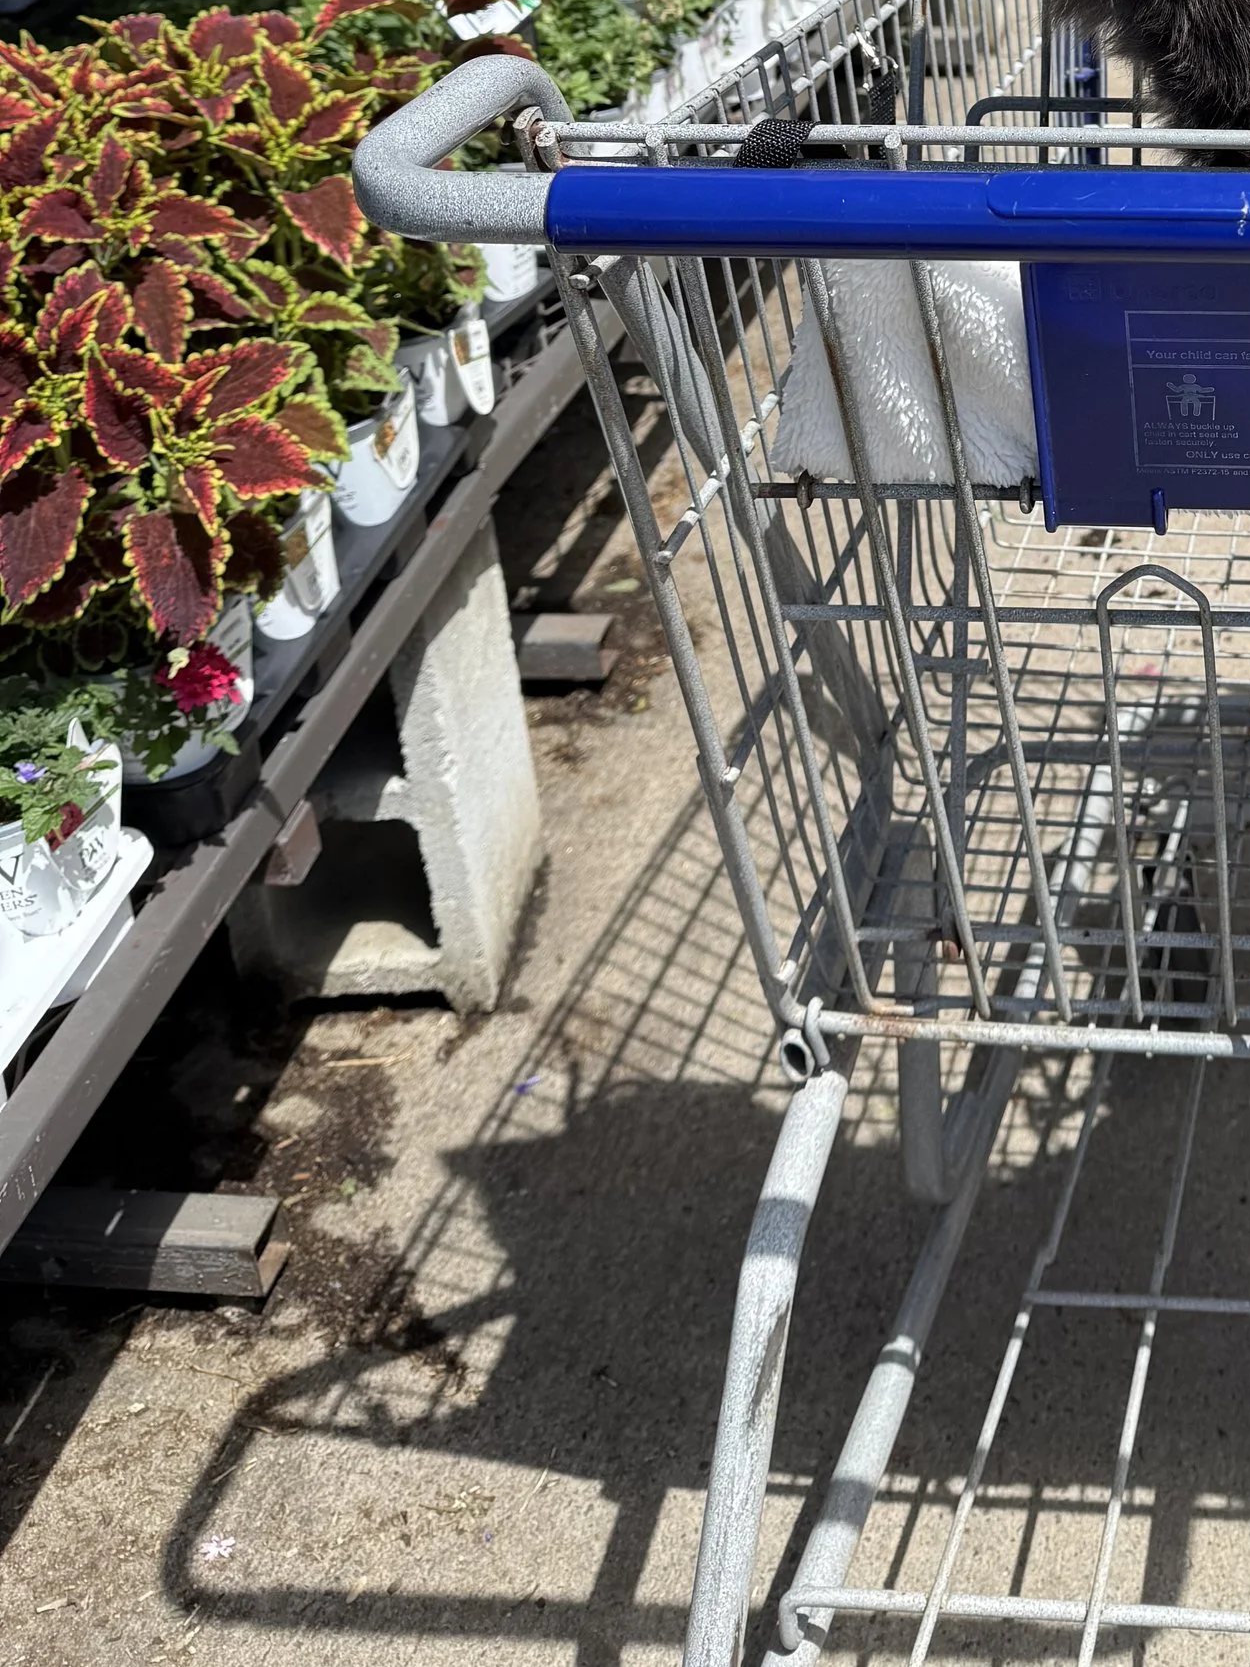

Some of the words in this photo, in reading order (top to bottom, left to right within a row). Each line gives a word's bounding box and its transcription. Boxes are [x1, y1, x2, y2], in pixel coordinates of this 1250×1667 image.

[1146, 349, 1177, 360] Your
[1179, 349, 1212, 361] child
[1214, 351, 1238, 361] can
[1143, 422, 1189, 430] ALWAYS
[1190, 422, 1220, 430] buckle
[1221, 431, 1239, 439] and
[1185, 450, 1219, 459] ONLY
[1221, 451, 1240, 459] use
[1191, 468, 1229, 476] F2372-15
